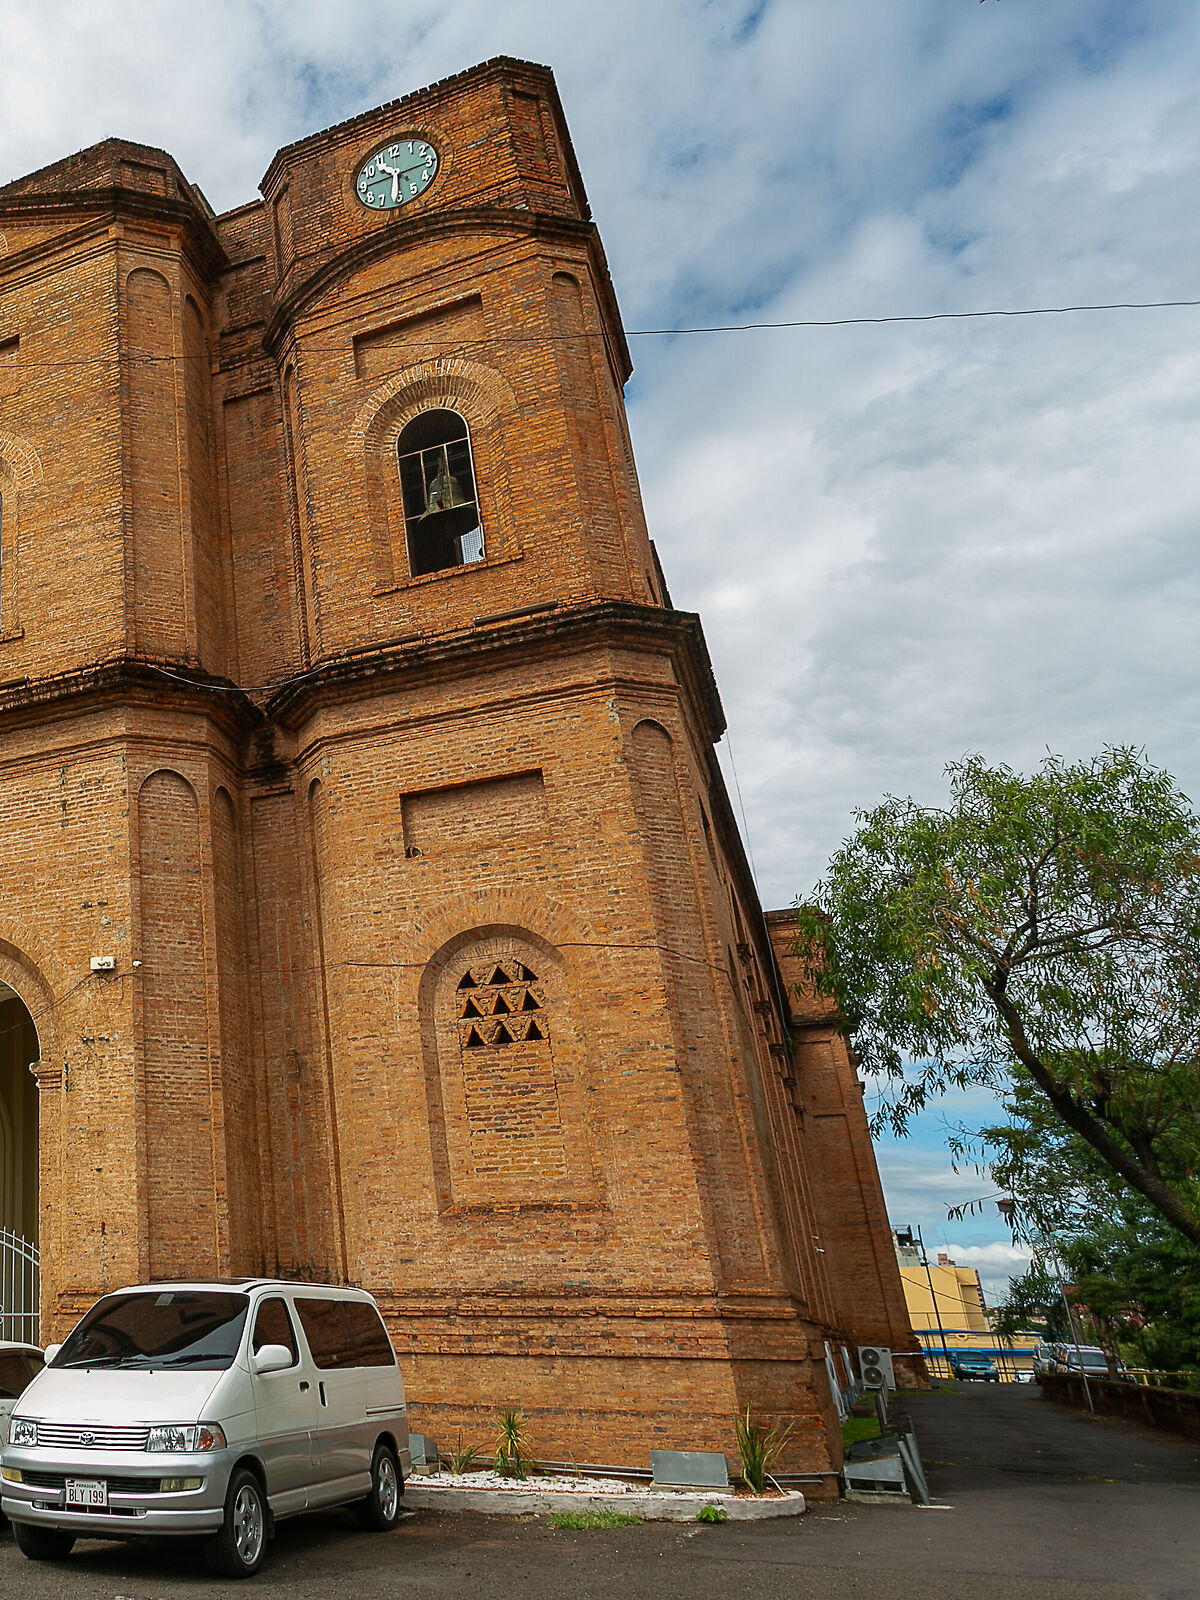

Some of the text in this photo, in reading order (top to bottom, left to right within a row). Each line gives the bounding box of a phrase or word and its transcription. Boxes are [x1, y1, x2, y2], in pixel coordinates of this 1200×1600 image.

[388, 144, 400, 158] 12
[408, 141, 414, 154] 1
[419, 144, 427, 157] 2
[374, 153, 384, 166] 11
[425, 155, 433, 167] 3
[364, 164, 375, 178] 10
[421, 170, 429, 181] 4
[360, 181, 367, 192] 9
[409, 182, 418, 194] 5
[366, 191, 374, 203] 8
[378, 193, 385, 206] 7
[397, 191, 403, 202] 6
[69, 1489, 104, 1504] BLY 199
